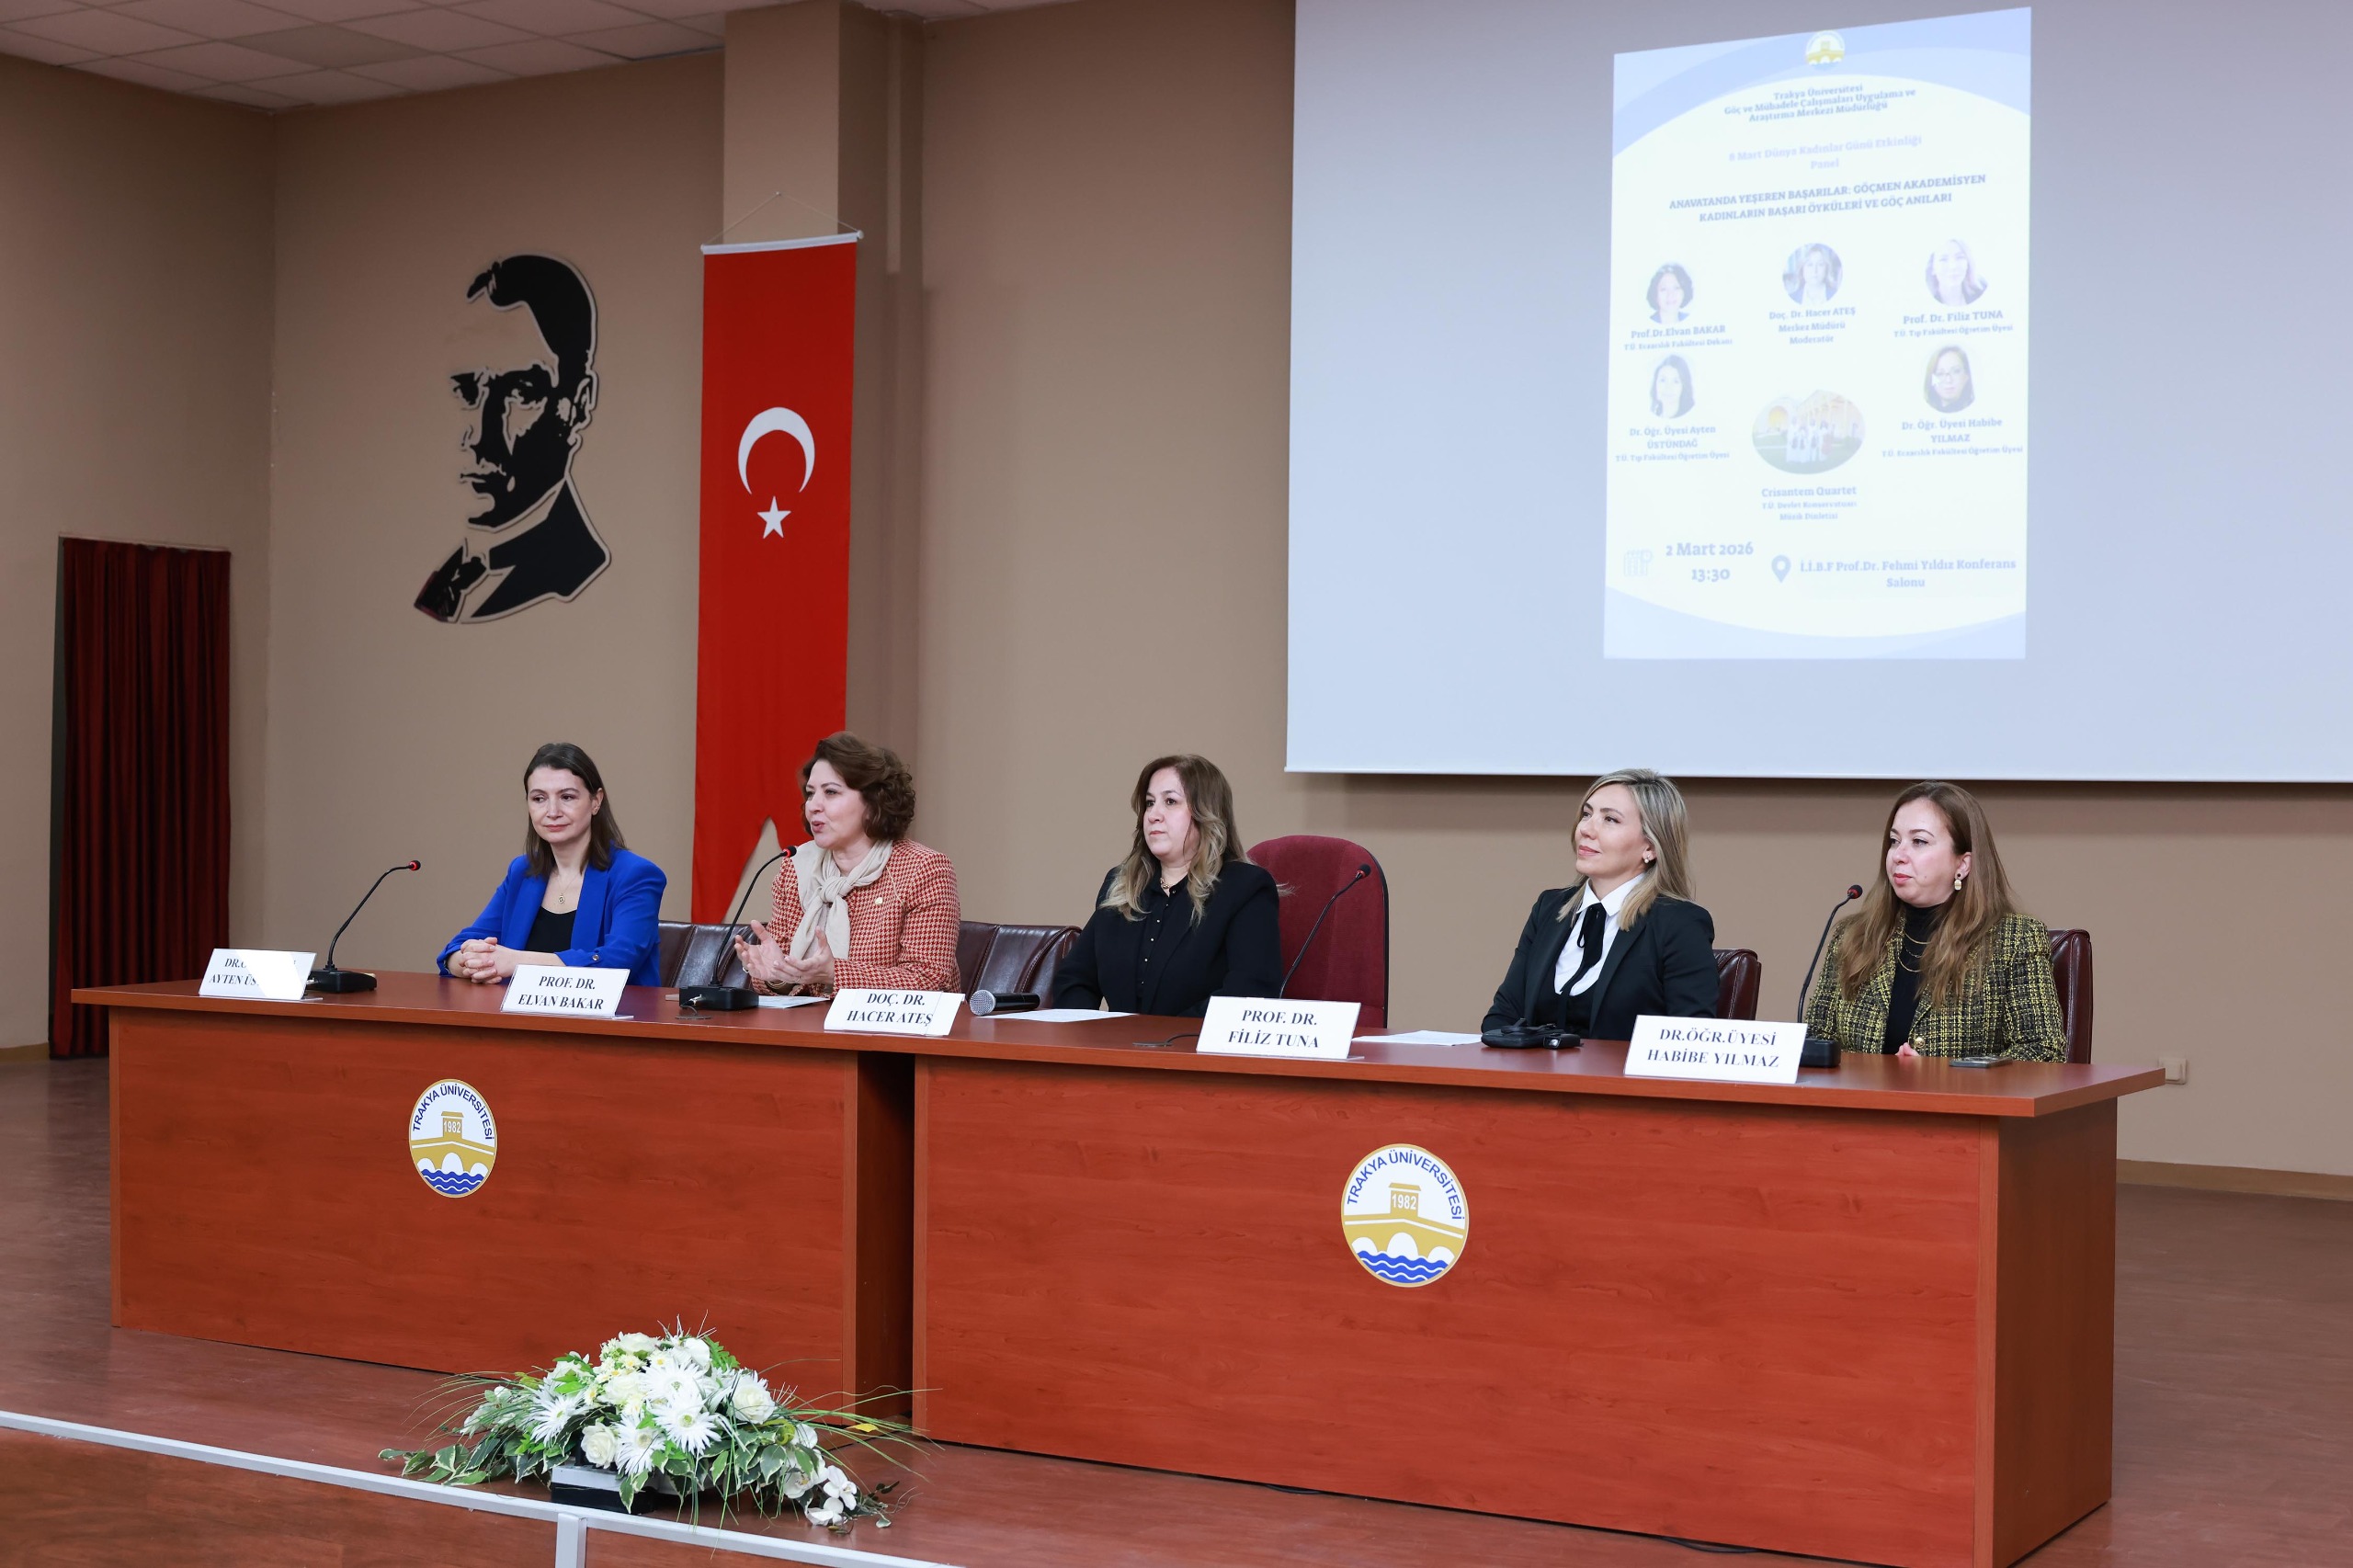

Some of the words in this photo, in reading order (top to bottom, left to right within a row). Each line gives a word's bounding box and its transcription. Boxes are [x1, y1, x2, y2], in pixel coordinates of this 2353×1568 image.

[1773, 90, 1805, 100] Trakya
[1807, 84, 1863, 97] Üniversitesi
[1724, 106, 1741, 115] Göç
[1755, 99, 1799, 111] Mübadele
[1855, 90, 1904, 103] Uygulama
[1905, 88, 1915, 97] ve
[1748, 111, 1794, 122] Araştırma
[1797, 106, 1834, 117] Merkezi
[1737, 149, 1762, 160] Mart
[1764, 146, 1797, 159] Dünya
[1799, 142, 1844, 154] Kadınlar
[1846, 138, 1873, 151] Günü
[1811, 157, 1839, 169] Panel
[1669, 196, 1736, 210] ANAVATANDA
[1738, 190, 1786, 204] YEŞEREN
[1788, 185, 1851, 199] BAŞARILAR:
[1853, 180, 1902, 195] GÖÇMEN
[1903, 174, 1986, 190] AKADEMİSYEN
[1699, 208, 1766, 222] KADINLARIN
[1768, 203, 1807, 217] BAŞARI
[1807, 199, 1863, 214] ÖYKÜLERİ
[1864, 199, 1879, 209] VE
[1881, 194, 1904, 209] GÖÇ
[1905, 192, 1952, 205] ANILARI
[1790, 310, 1803, 318] Dr.
[1805, 309, 1832, 317] Hacer
[1833, 306, 1856, 316] ATEŞ
[1903, 313, 1927, 324] Prof.
[1930, 312, 1945, 323] Dr.
[1972, 310, 2004, 320] TUNA
[1693, 324, 1725, 335] BAKAR
[1630, 427, 1643, 437] Dr.
[1664, 425, 1688, 437] Üyesi
[1690, 425, 1716, 436] Ayten
[1902, 421, 1916, 430] Dr.
[1917, 418, 1938, 431] Öğr.
[1939, 417, 1966, 429] Üyesi
[1968, 416, 2003, 427] Habibe
[1646, 438, 1699, 449] ÜSTÜNDAĞ
[1930, 434, 1971, 443] YILMAZ
[1760, 487, 1814, 497] Crisantem
[1816, 485, 1858, 496] Quartet
[1665, 544, 1673, 556] 2
[1676, 542, 1715, 556] Mart
[1719, 540, 1754, 555] 2026
[1882, 559, 1918, 571] Fehmi
[1920, 558, 1954, 570] Yıldız
[1956, 557, 2017, 570] Konferans
[1690, 567, 1731, 583] 13:30
[1886, 576, 1926, 588] Salonu
[209, 973, 244, 985] AYTEN
[539, 975, 573, 989] PROF.
[575, 977, 596, 990] DR.
[518, 994, 559, 1007] ELVAN
[560, 996, 604, 1010] BAKAR
[867, 993, 899, 1006] DOÇ.
[903, 994, 926, 1006] DR.
[846, 1010, 895, 1023] HACER
[896, 1012, 934, 1027] ATEŞ
[1242, 1009, 1287, 1024] PROF.
[1291, 1012, 1318, 1026] DR.
[1228, 1028, 1272, 1046] FİLİZ
[1276, 1033, 1319, 1048] TUNA
[1659, 1027, 1778, 1046] DR.ÖĞR.ÜYESİ
[1647, 1047, 1709, 1063] HABİBE
[1713, 1052, 1779, 1068] YILMAZ
[413, 1090, 440, 1131] TRAKYA
[439, 1084, 494, 1140] ÜNİVERSİTESİ
[443, 1120, 461, 1133] 1982
[1347, 1156, 1388, 1205] TRAKYA
[1388, 1149, 1465, 1220] ÜNİVERSİTESİ
[1392, 1193, 1417, 1210] 1982
